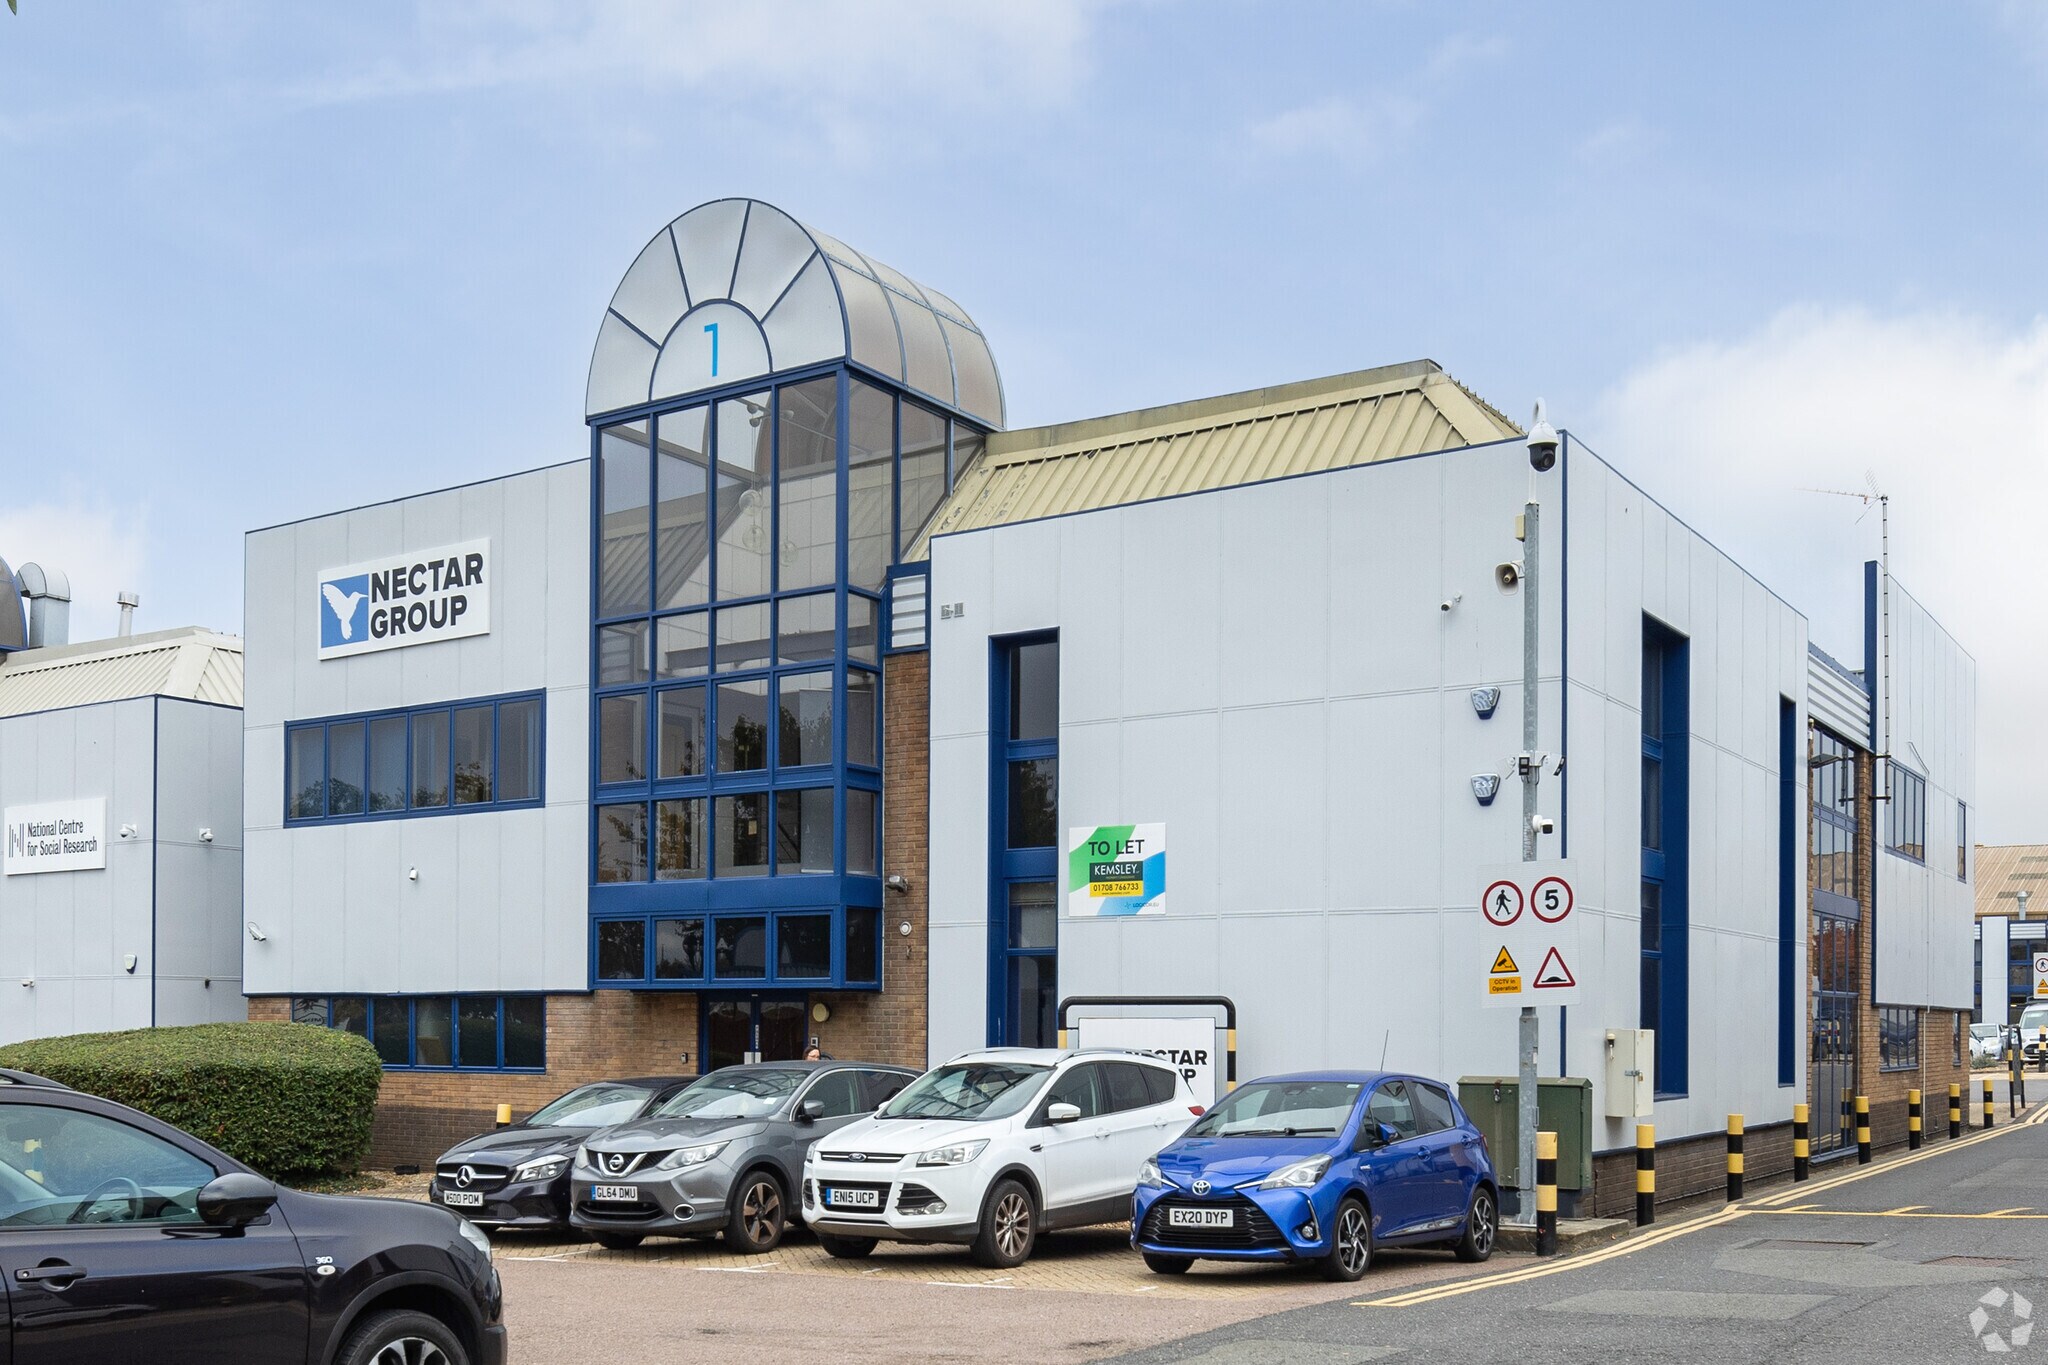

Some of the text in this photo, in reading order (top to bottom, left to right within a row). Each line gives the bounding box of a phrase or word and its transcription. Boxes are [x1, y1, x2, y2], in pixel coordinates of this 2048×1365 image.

[704, 322, 718, 377] 1
[371, 552, 484, 603] NECTAR
[370, 594, 468, 639] GROUP
[27, 818, 84, 837] National Centre
[27, 835, 98, 857] for Social Research
[1088, 839, 1145, 856] TO LET
[1094, 864, 1137, 875] KEMSLEY
[1093, 882, 1139, 892] 01708 766733
[1545, 889, 1559, 911] 5
[597, 1186, 636, 1199] GL64 DMU
[834, 1190, 874, 1204] EN15 UCP
[1174, 1210, 1228, 1224] EX20 DYP
[316, 1256, 333, 1264] 360
